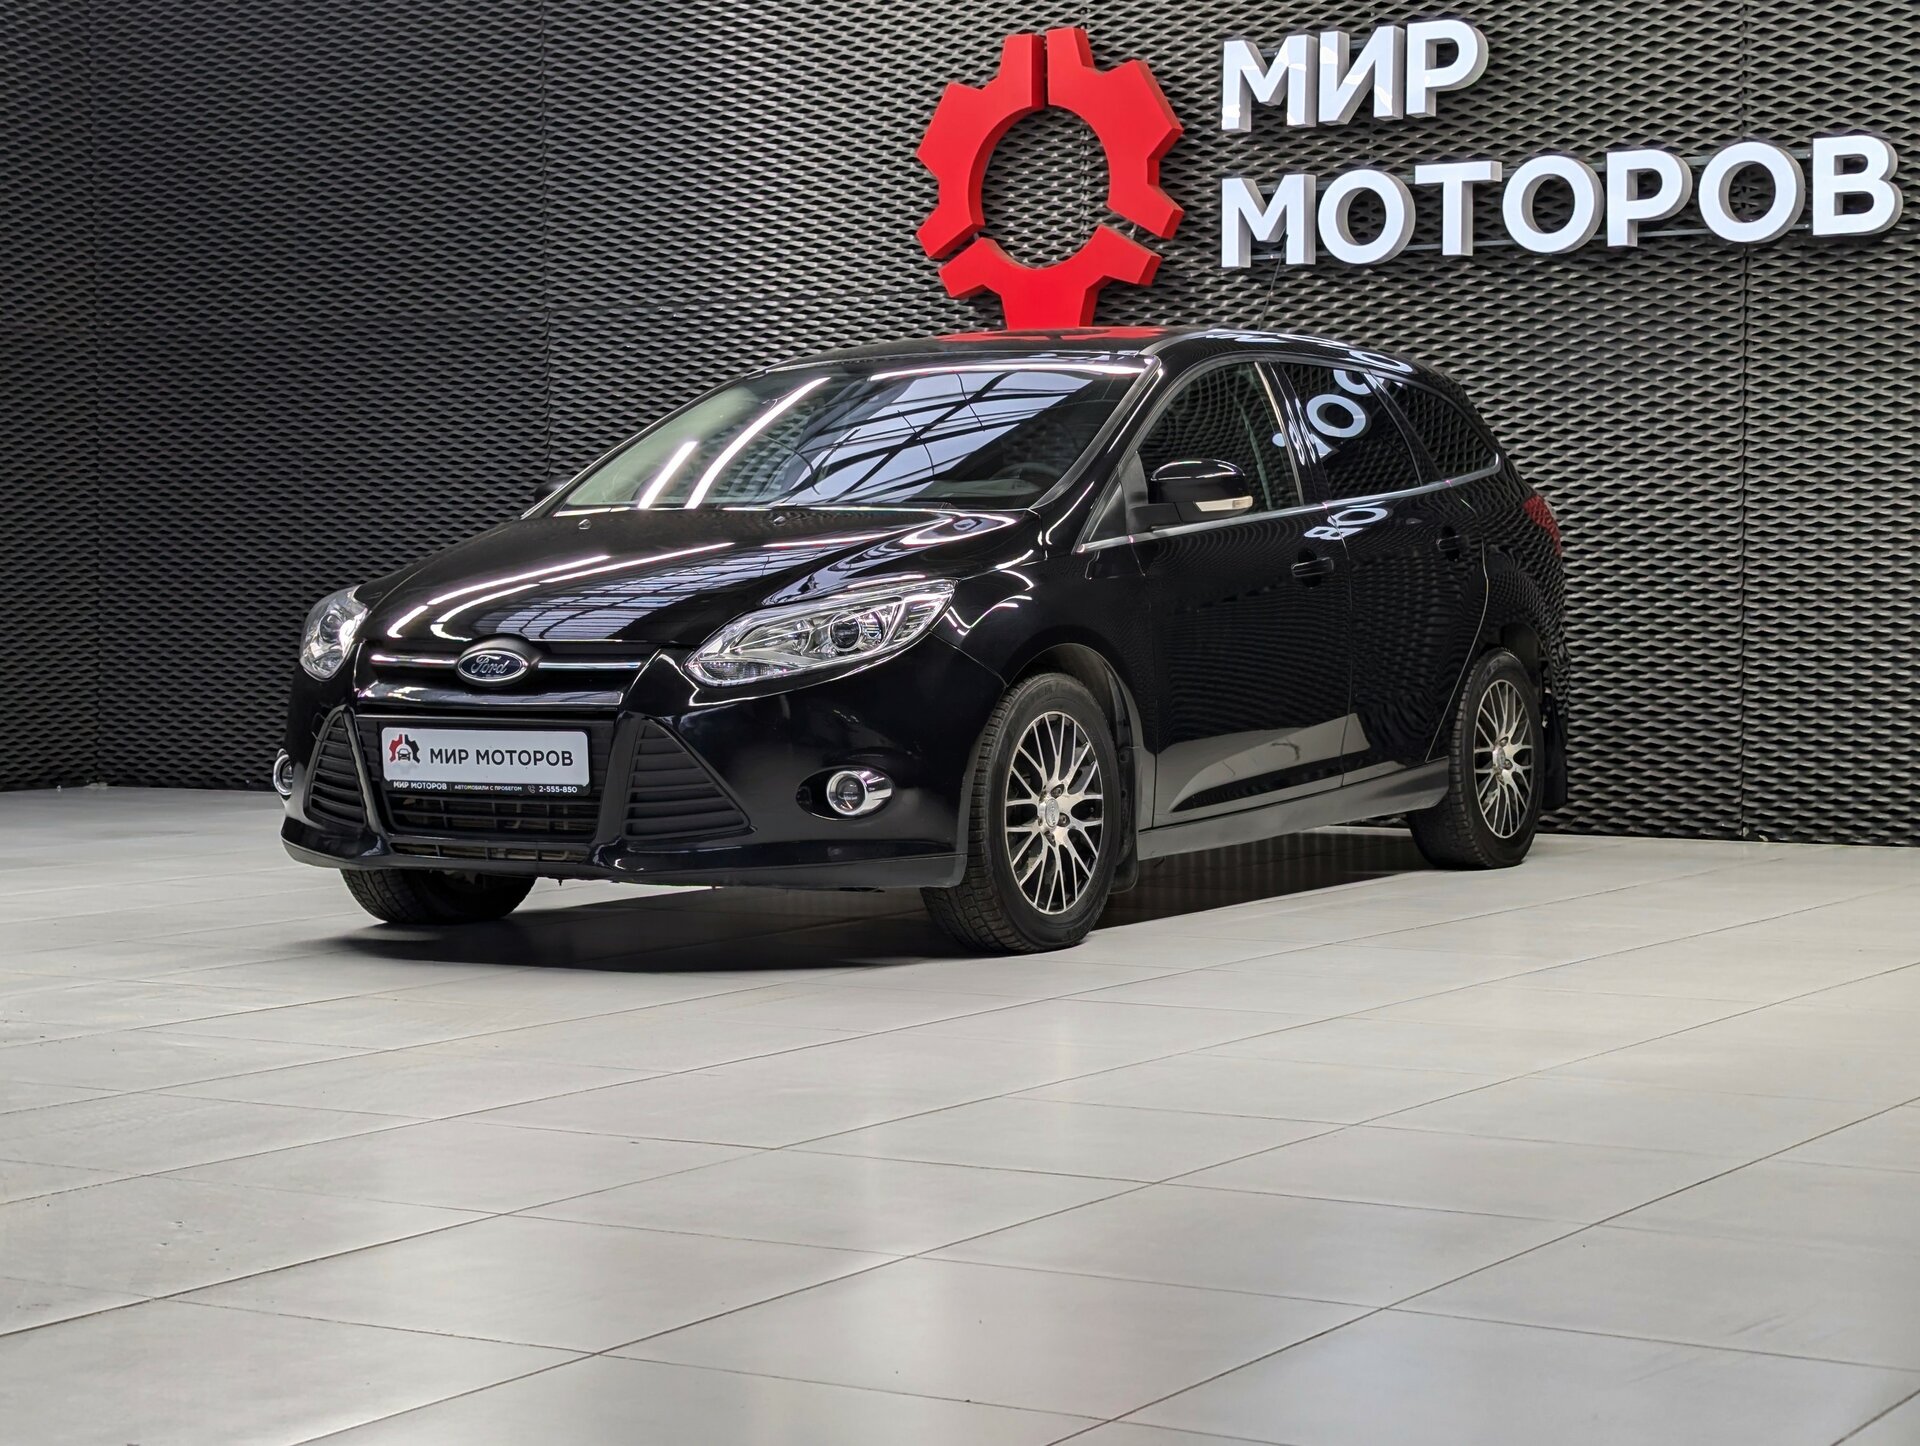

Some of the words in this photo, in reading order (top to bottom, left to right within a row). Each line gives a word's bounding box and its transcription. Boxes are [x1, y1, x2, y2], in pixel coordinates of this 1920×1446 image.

[1221, 19, 1489, 133] МИР
[1221, 134, 1902, 268] МОТОРОВ
[470, 654, 510, 674] Ford
[429, 748, 469, 764] МИР
[476, 749, 574, 767] МОТОРОВ
[393, 781, 409, 789] МИР
[410, 782, 447, 790] МОТОРОВ
[539, 785, 578, 793] 2-555-850
